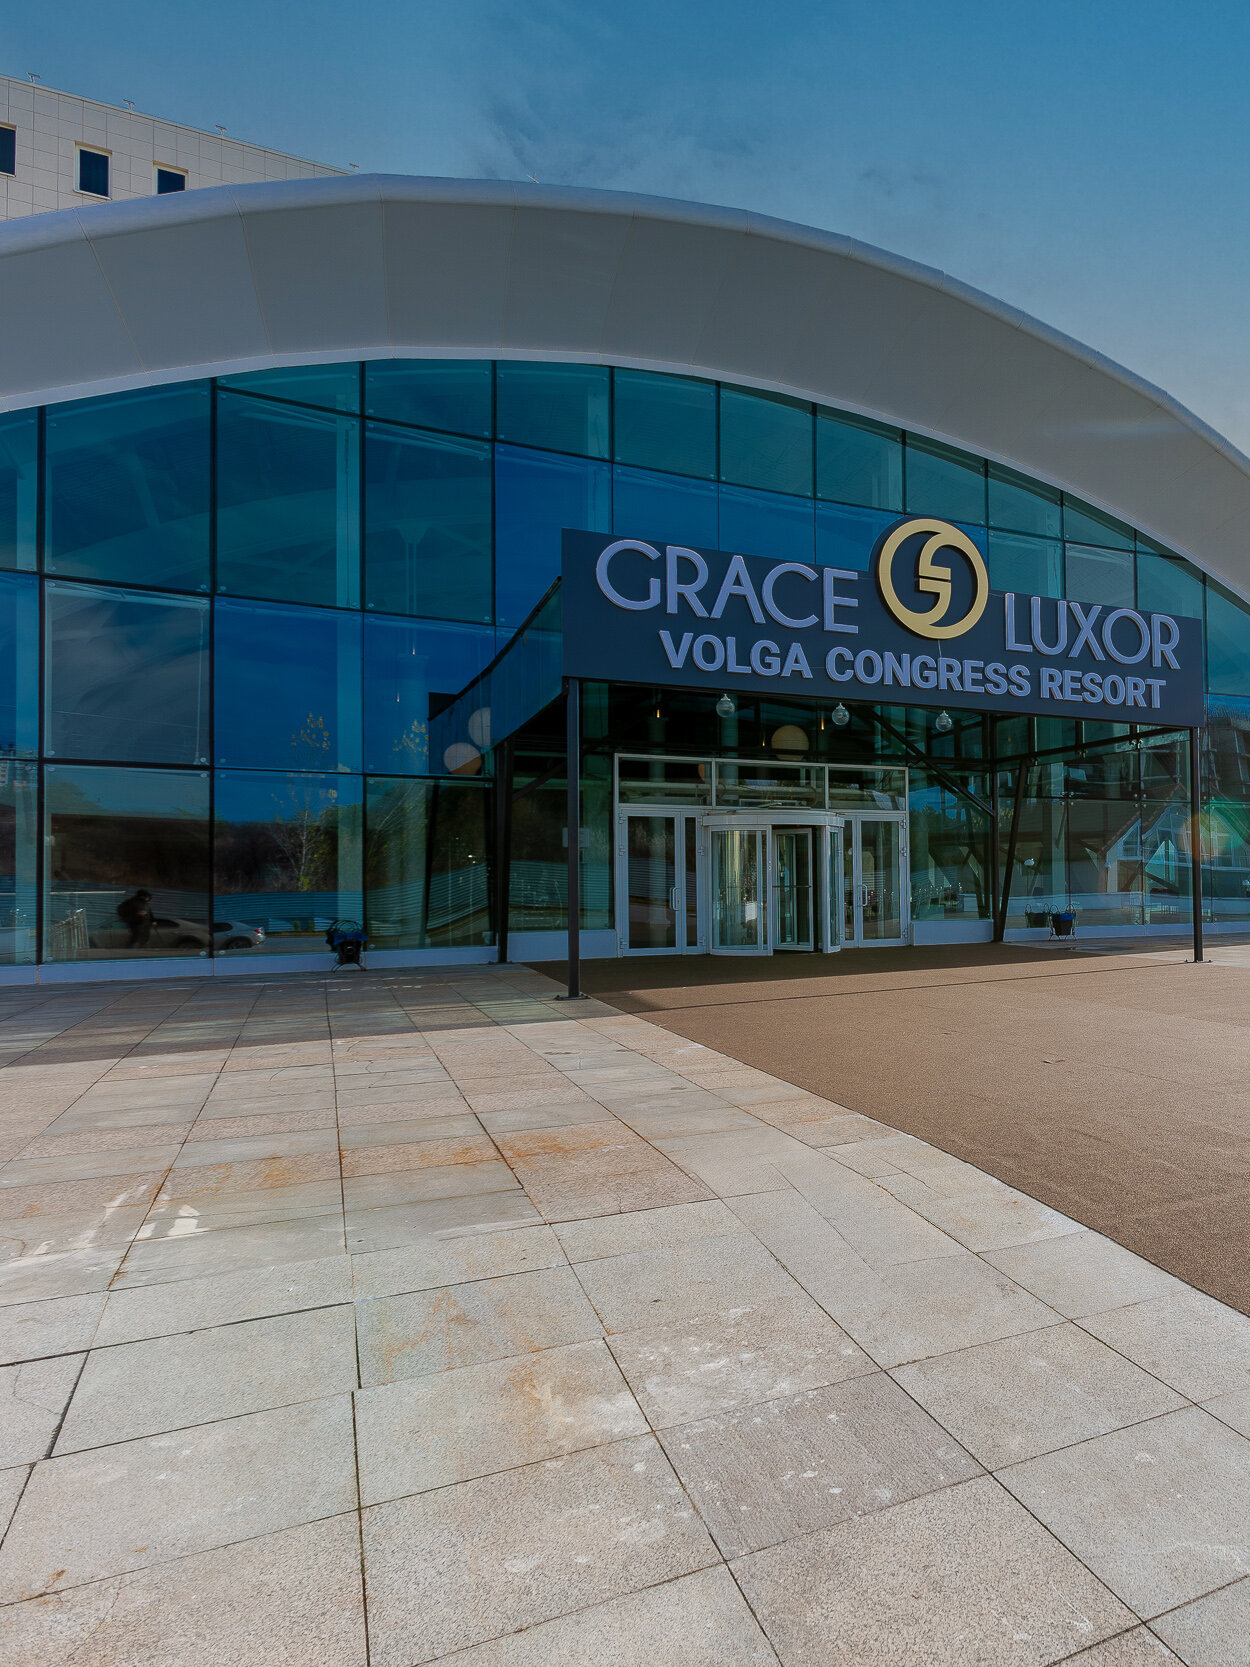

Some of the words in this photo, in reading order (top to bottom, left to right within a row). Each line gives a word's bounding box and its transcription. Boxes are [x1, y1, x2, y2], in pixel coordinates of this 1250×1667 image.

[596, 539, 860, 634] GRACE
[1004, 592, 1181, 670] LUXOR
[659, 630, 813, 679] VOLGA
[826, 647, 1031, 697] CONGRESS
[1041, 668, 1166, 709] RESORT
